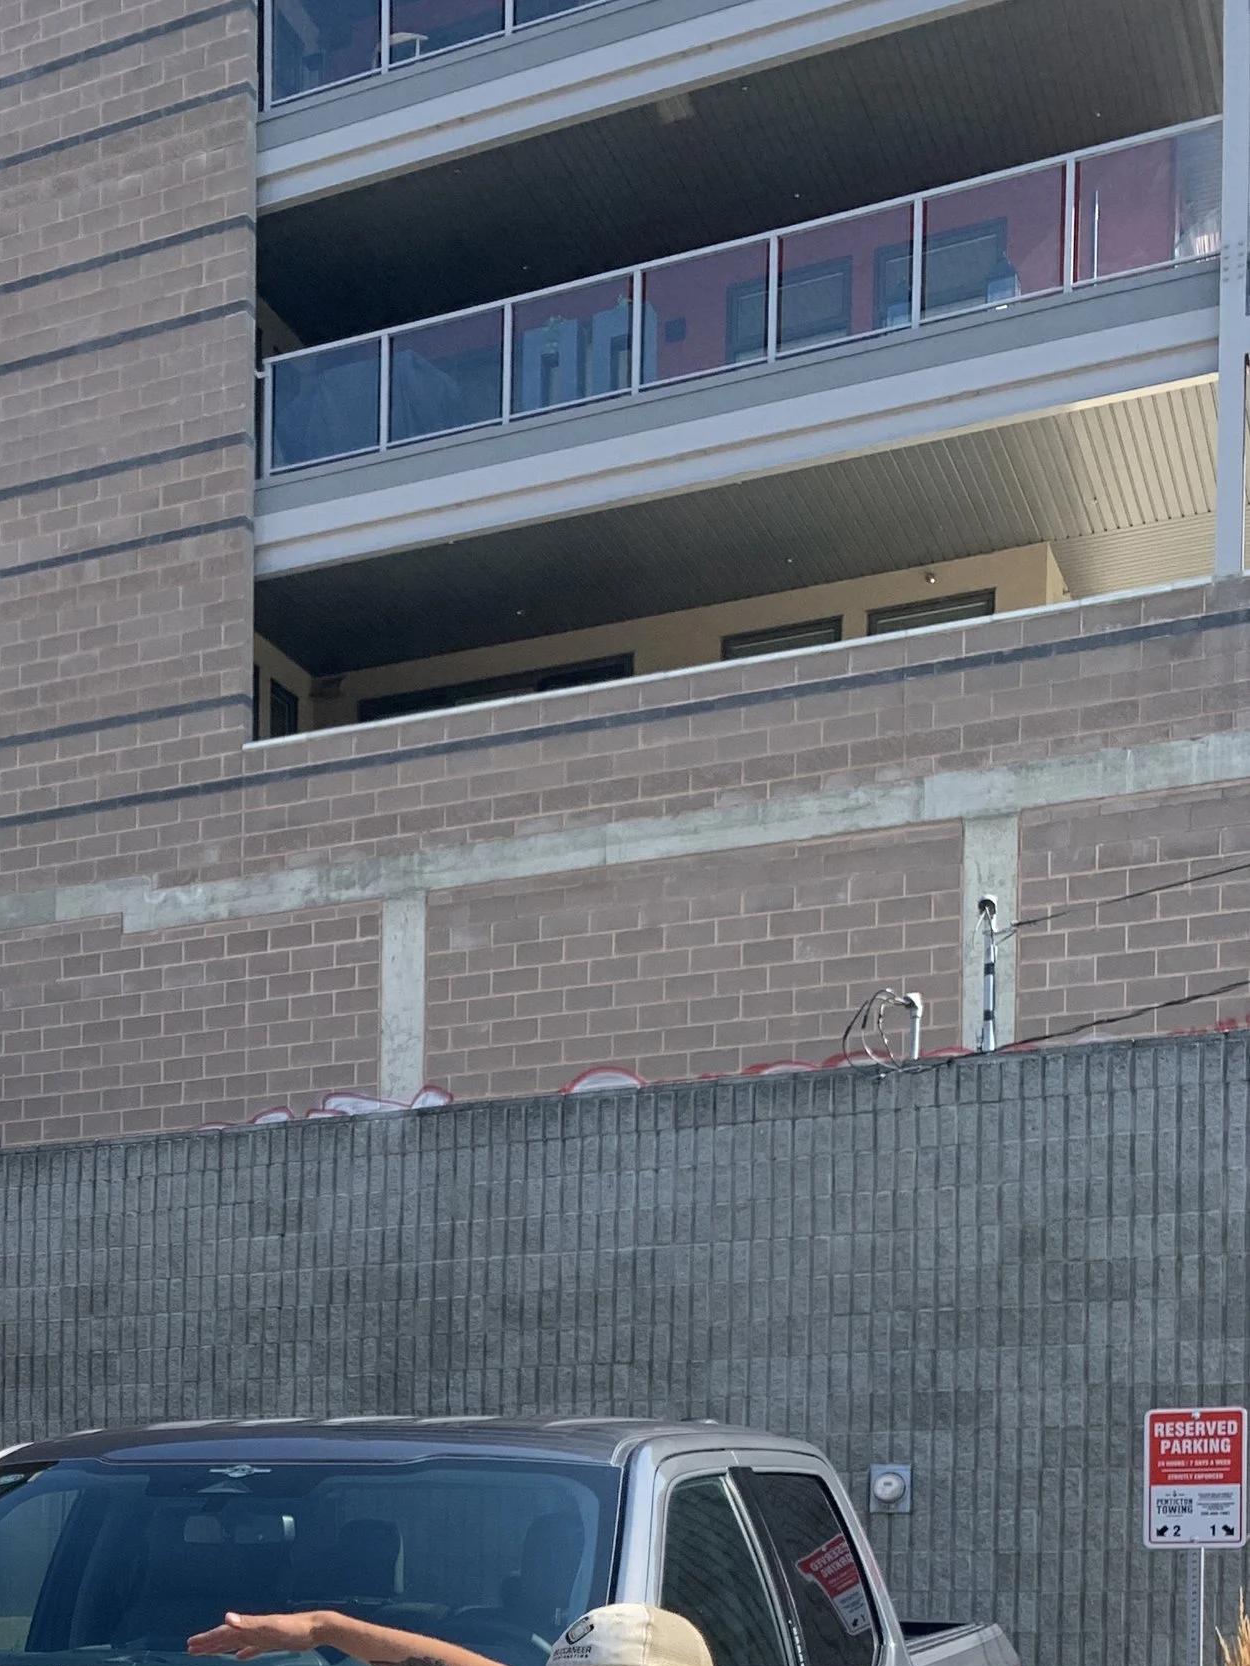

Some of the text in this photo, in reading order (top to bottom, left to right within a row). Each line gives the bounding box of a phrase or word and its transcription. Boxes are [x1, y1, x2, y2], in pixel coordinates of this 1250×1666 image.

[1154, 1420, 1238, 1437] RESERVED
[1160, 1438, 1231, 1455] PARKING
[1156, 1498, 1193, 1506] PENTICTON
[1157, 1505, 1193, 1514] TOWING
[1173, 1525, 1181, 1537] 2
[1210, 1524, 1216, 1536] 1
